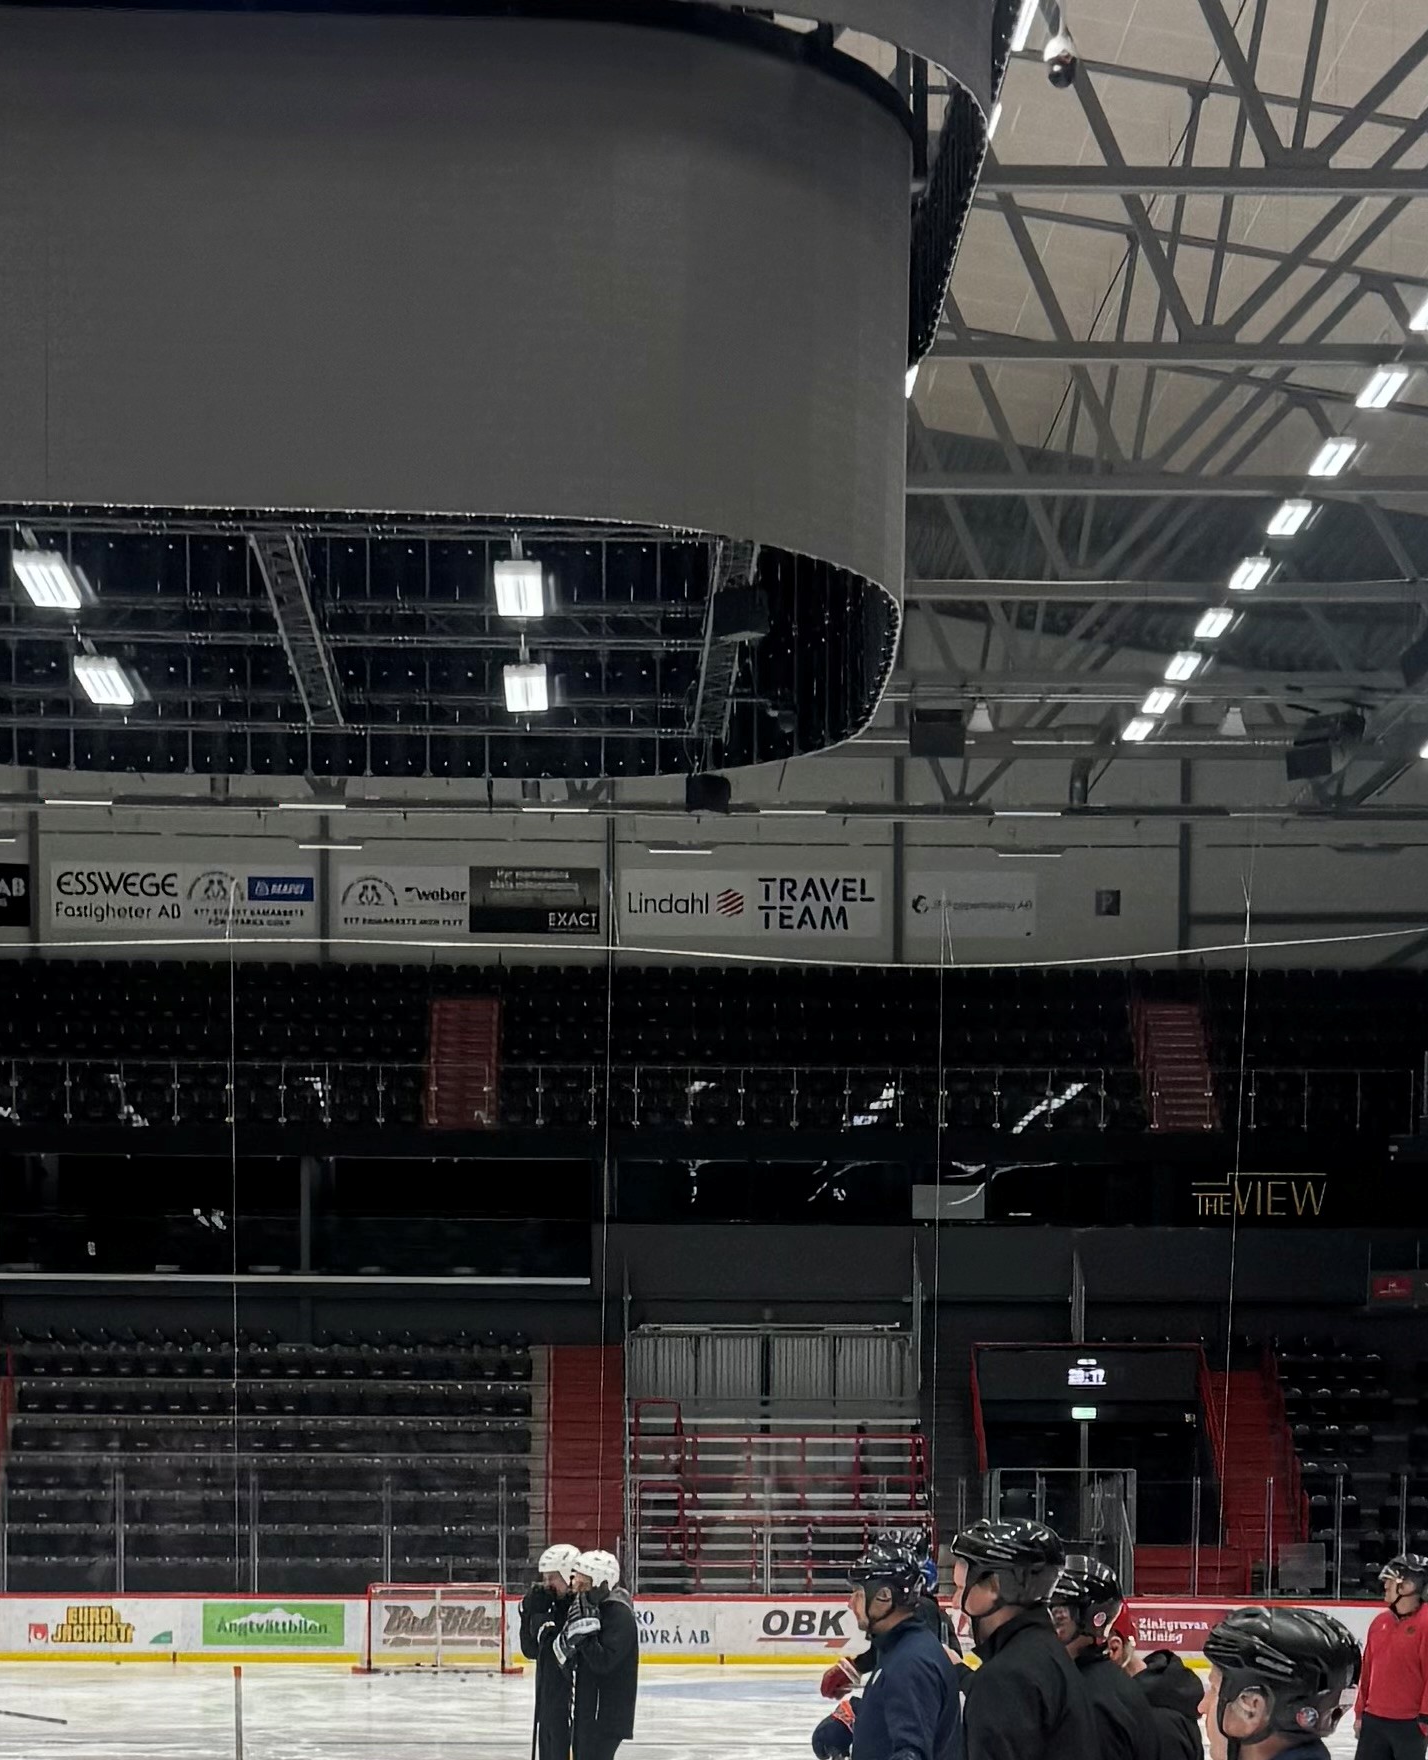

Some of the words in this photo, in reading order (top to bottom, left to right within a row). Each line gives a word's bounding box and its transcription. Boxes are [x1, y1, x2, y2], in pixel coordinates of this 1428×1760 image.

[56, 871, 179, 897] ESSWEGE
[757, 877, 876, 903] TRAVEL
[55, 902, 152, 923] Fastigheter
[158, 903, 181, 919] AB
[627, 892, 710, 915] Lindahl
[548, 912, 598, 928] EXACT
[757, 905, 850, 931] TEAM
[1192, 1192, 1232, 1216] THE
[1233, 1180, 1328, 1216] VIEW
[67, 1605, 113, 1625] EURO
[762, 1609, 848, 1637] OBK
[1138, 1617, 1209, 1632] Zinkgruvan
[51, 1622, 134, 1643] JACKPOT
[688, 1629, 711, 1644] AB
[1138, 1630, 1184, 1645] Mining
